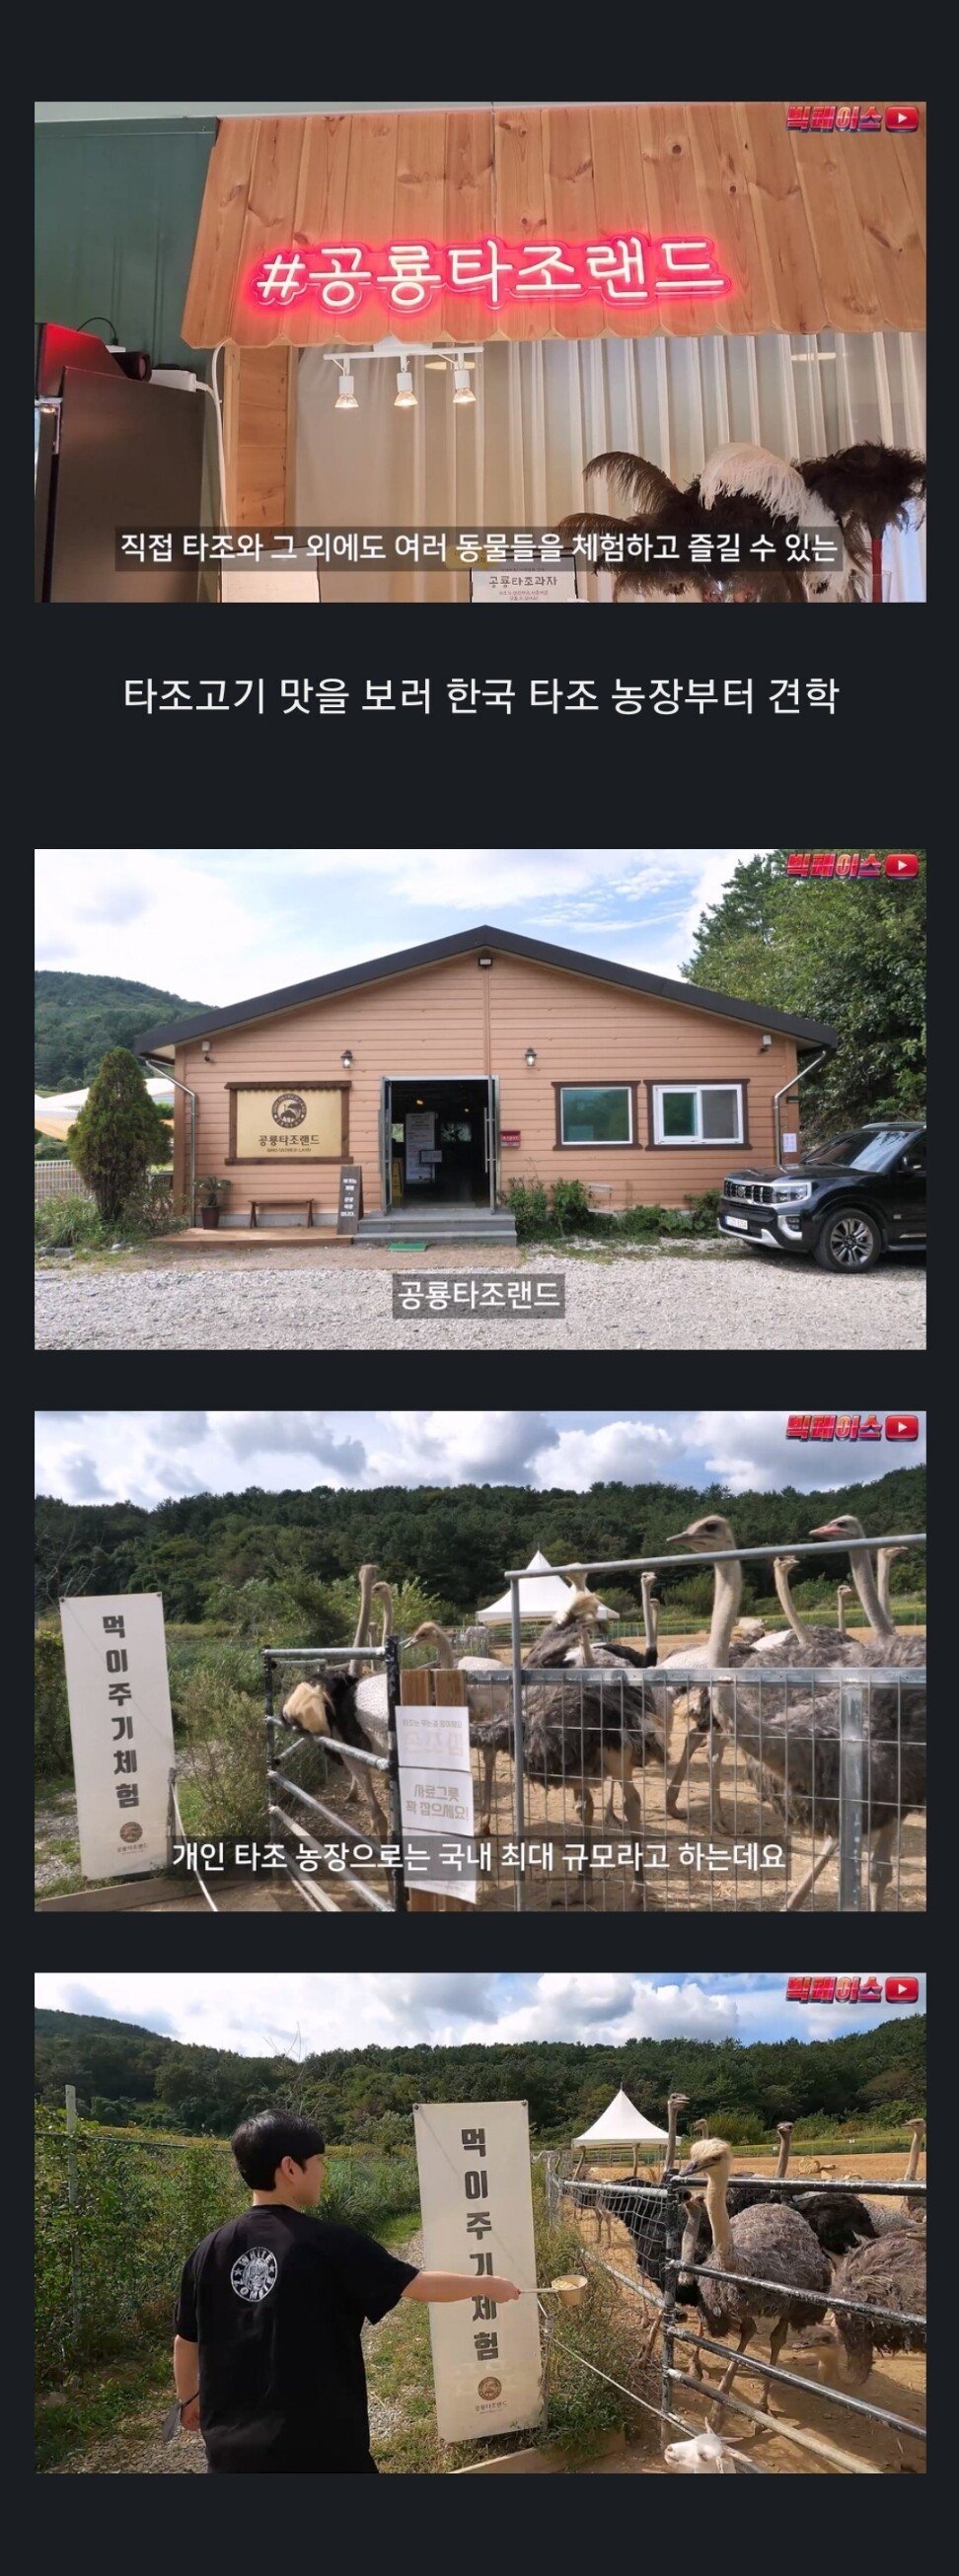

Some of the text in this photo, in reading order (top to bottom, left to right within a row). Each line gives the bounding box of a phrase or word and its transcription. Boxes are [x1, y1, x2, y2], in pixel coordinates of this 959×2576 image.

[256, 236, 725, 307] #공룡타조랜드
[488, 575, 557, 589] 공룡타조과자
[258, 1134, 321, 1147] 공룡타조랜드
[103, 1614, 139, 1809] 먹이주기체험
[414, 1784, 459, 1802] 사료그릇
[238, 2250, 274, 2266] WHITE
